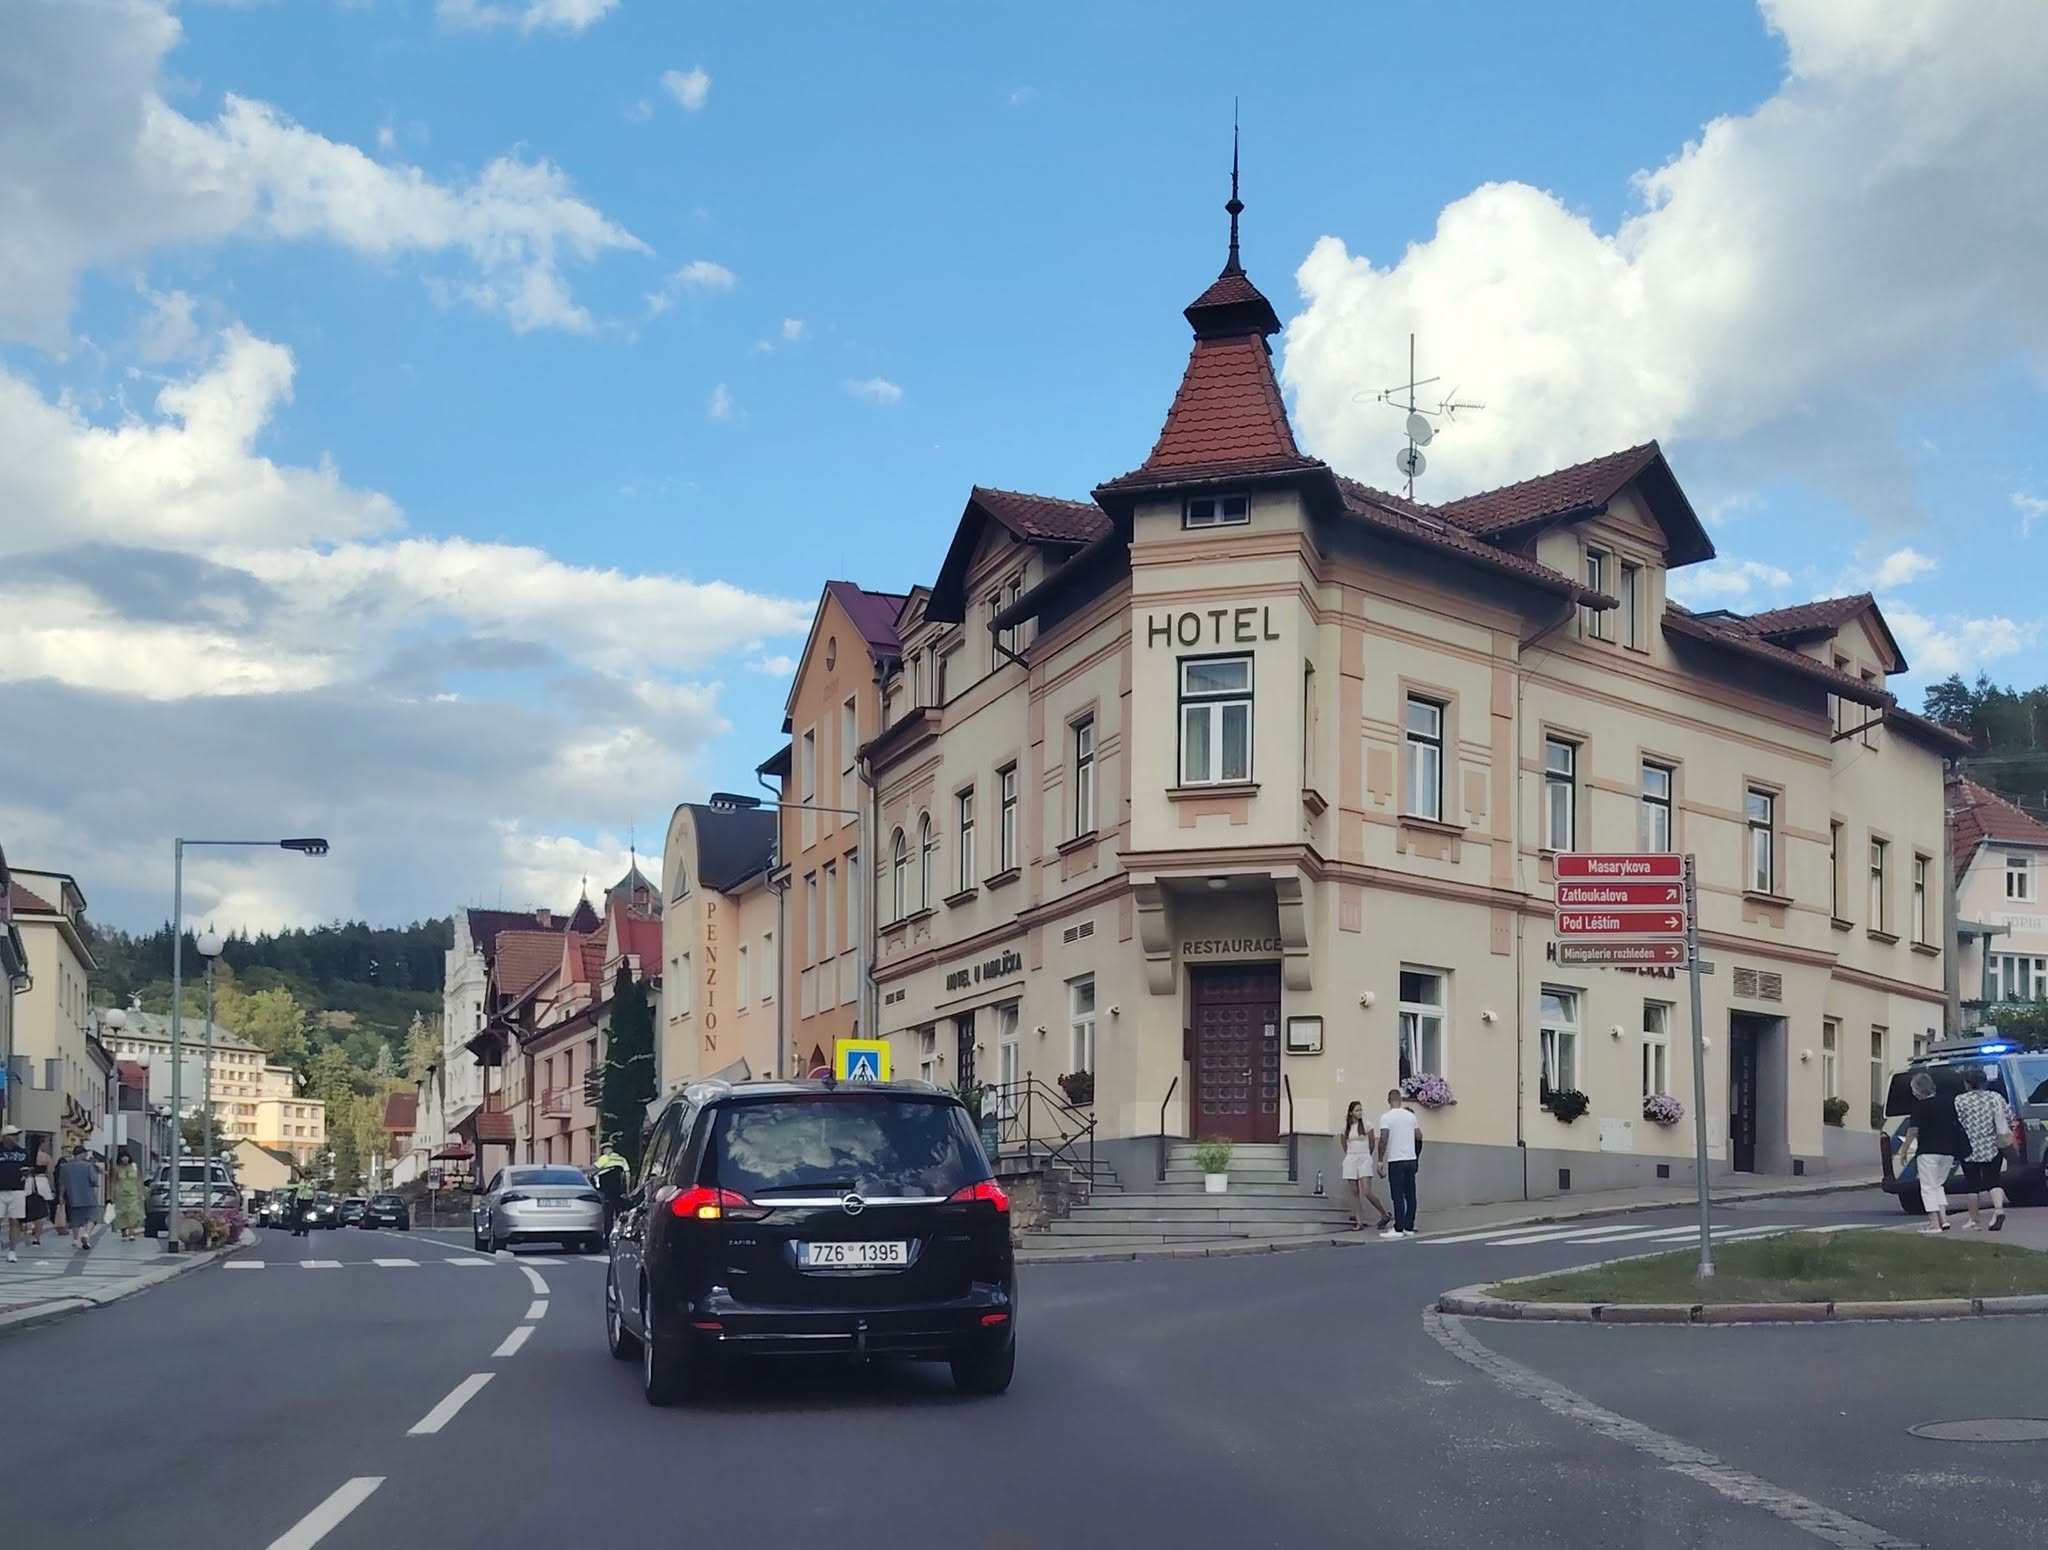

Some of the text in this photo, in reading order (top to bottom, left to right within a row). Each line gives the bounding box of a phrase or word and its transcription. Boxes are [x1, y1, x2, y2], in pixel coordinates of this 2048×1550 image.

[1148, 606, 1280, 648] HOTEL
[1587, 859, 1651, 876] Masarykova
[1561, 888, 1628, 902] Zatloukalova
[1563, 915, 1583, 930] Pod
[1183, 938, 1283, 955] RESTAURACE
[1564, 948, 1612, 961] Minigalerie
[1613, 947, 1655, 959] rozhleden
[704, 902, 717, 1052] PENZION
[946, 969, 971, 991] HOTEL
[974, 965, 980, 984] U
[813, 1245, 844, 1262] 7Z6
[859, 1244, 899, 1261] 1395
